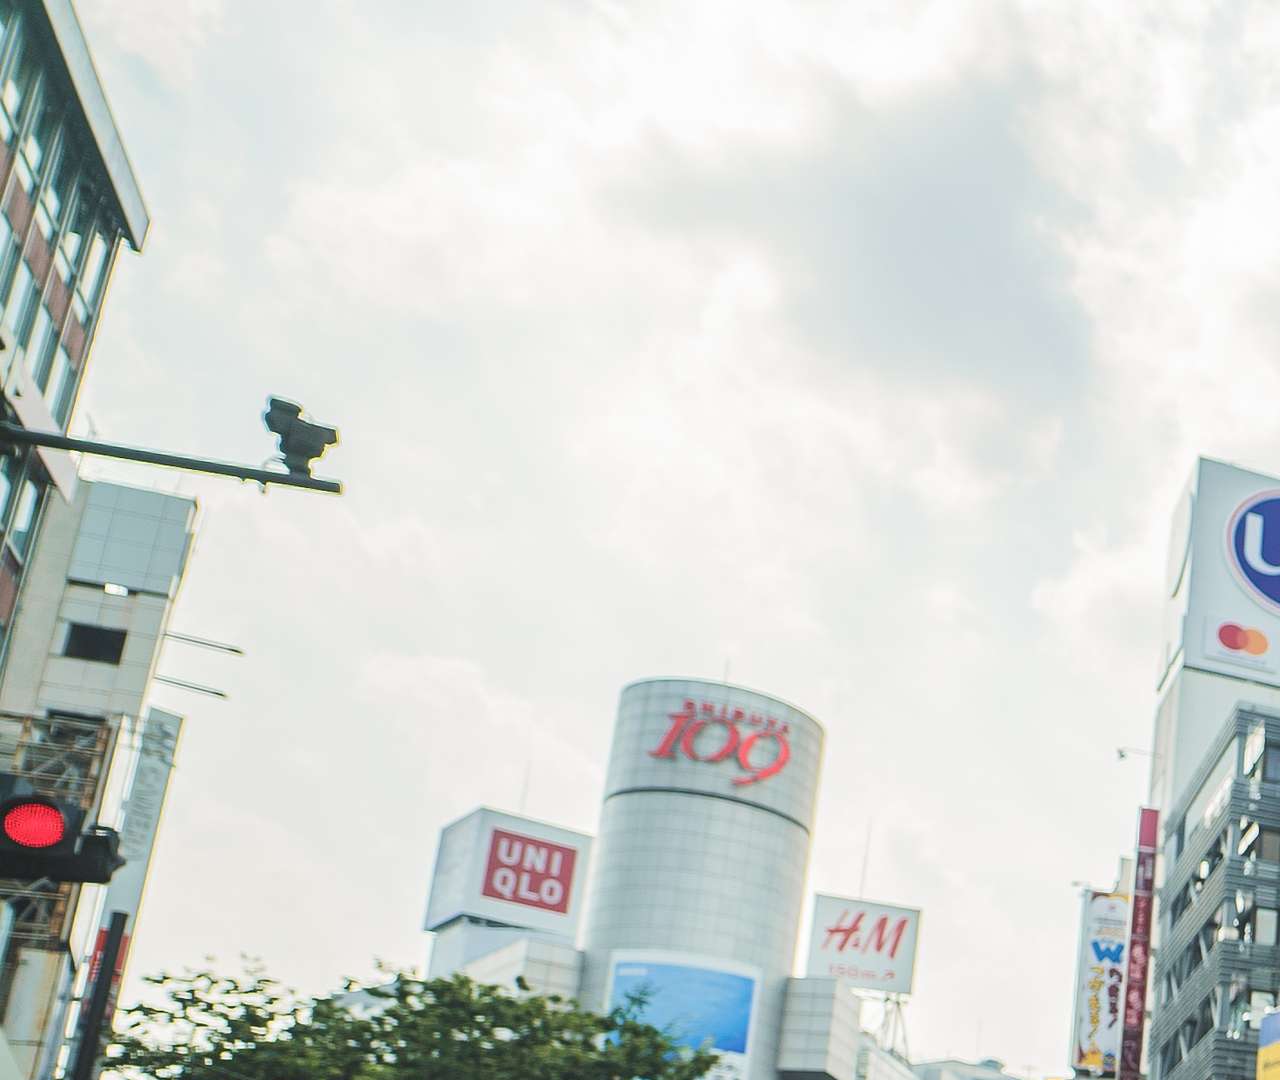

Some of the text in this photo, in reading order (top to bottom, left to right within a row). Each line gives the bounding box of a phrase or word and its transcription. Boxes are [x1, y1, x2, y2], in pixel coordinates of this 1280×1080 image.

[649, 711, 791, 788] 109
[497, 838, 563, 878] UNI
[492, 866, 564, 905] QLO
[822, 908, 909, 960] H&M
